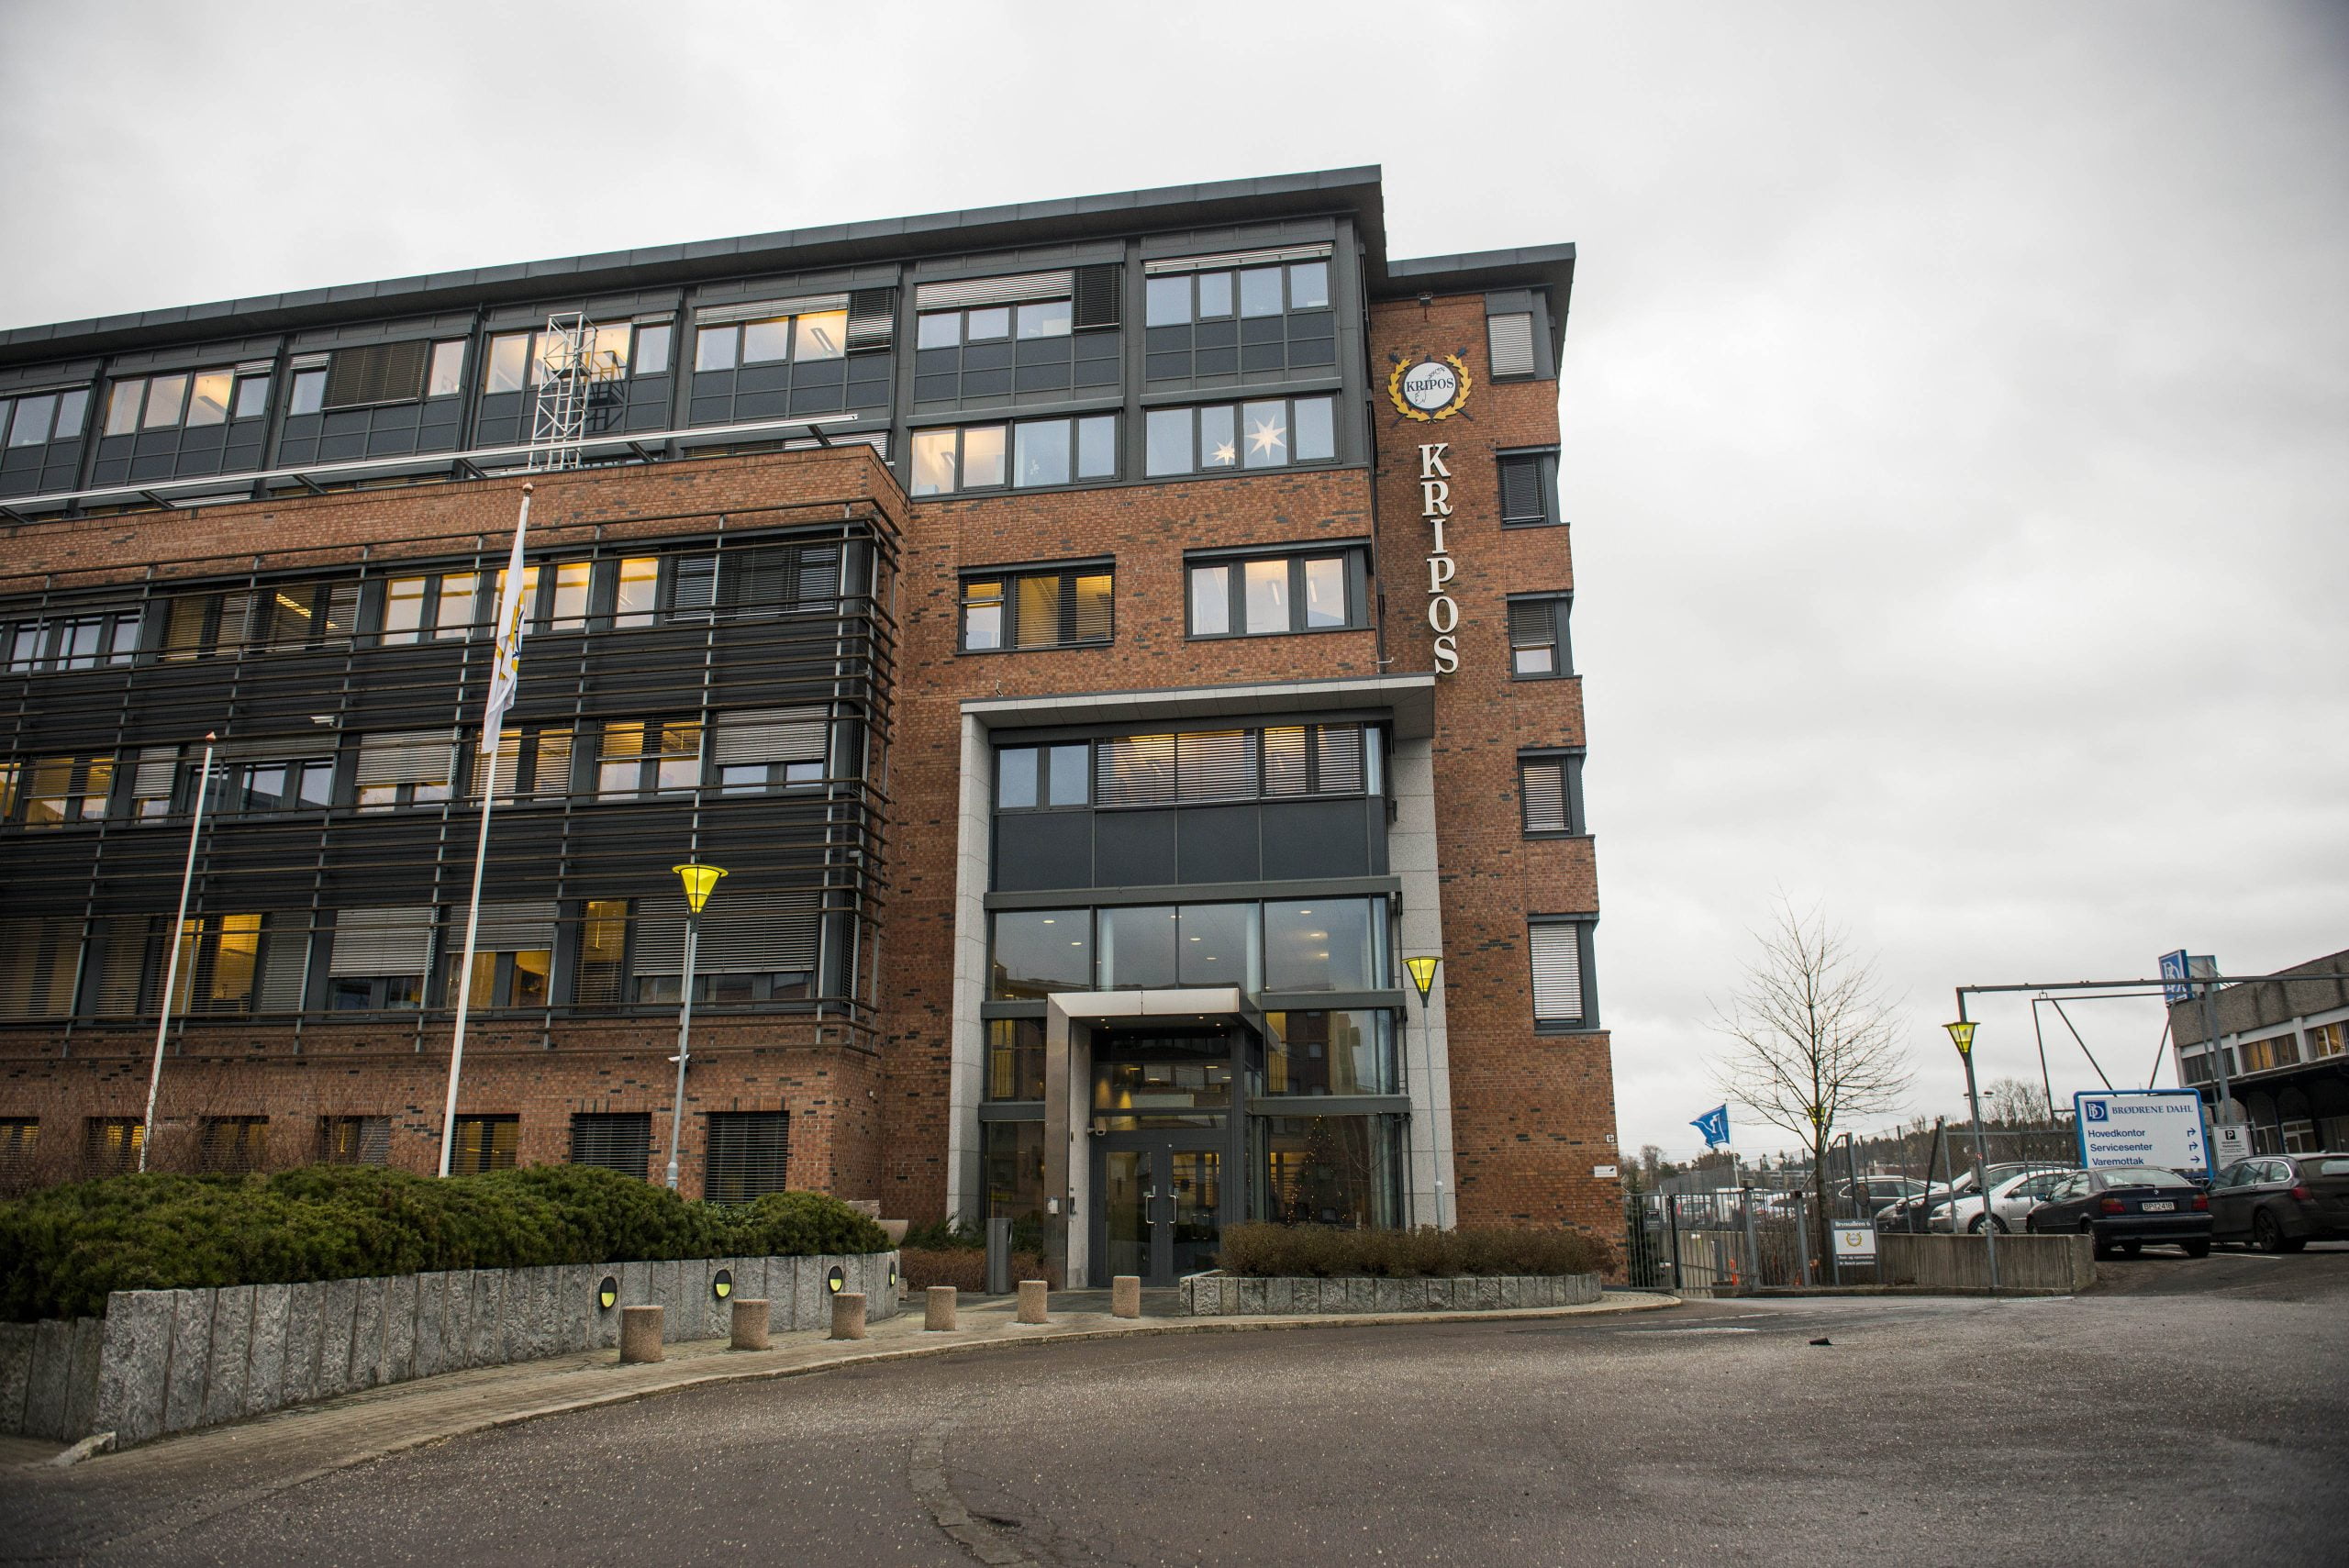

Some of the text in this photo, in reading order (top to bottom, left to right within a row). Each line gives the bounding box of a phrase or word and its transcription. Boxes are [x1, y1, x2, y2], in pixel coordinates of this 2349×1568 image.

[1406, 377, 1454, 393] KRIPOS
[1418, 442, 1459, 675] KRIPOS
[2111, 1105, 2194, 1115] BRØDRENE DAHL
[2087, 1129, 2145, 1138] Hovedkontor
[2090, 1143, 2153, 1152] Servicesenter
[2092, 1157, 2144, 1166] Varemottak
